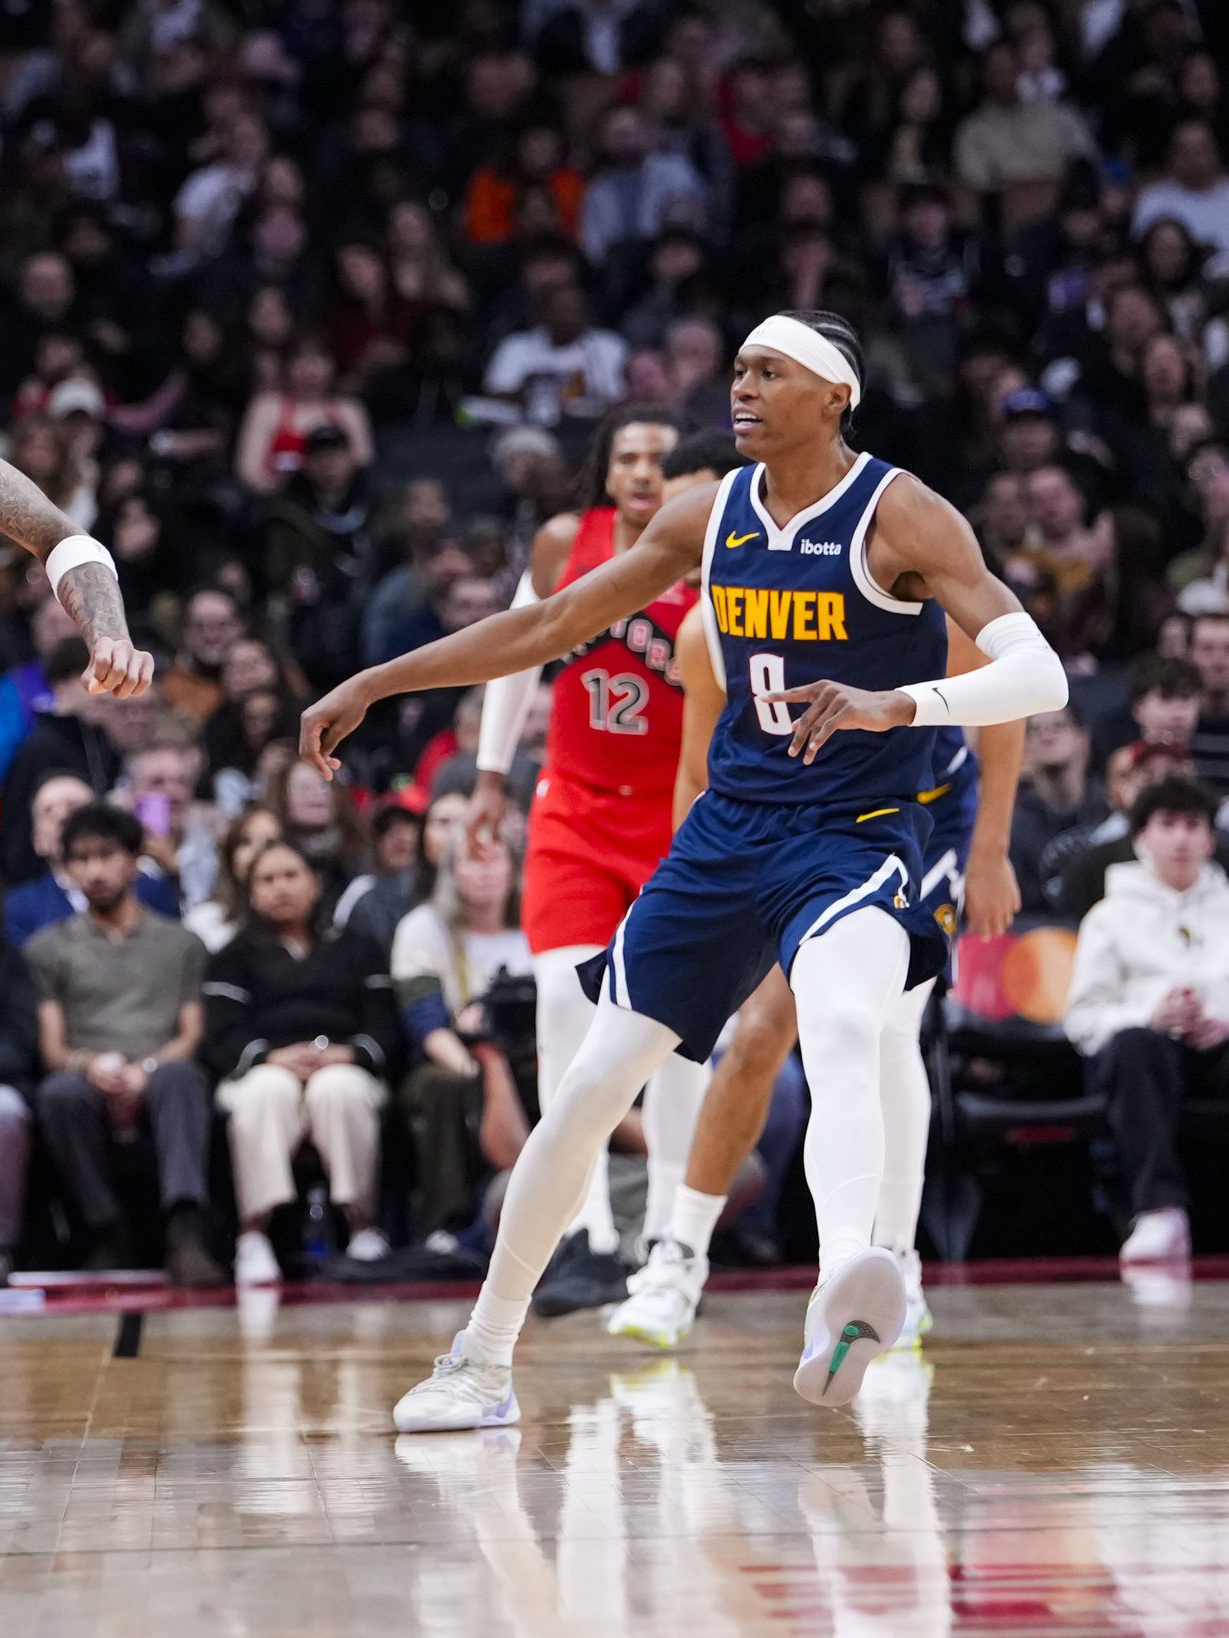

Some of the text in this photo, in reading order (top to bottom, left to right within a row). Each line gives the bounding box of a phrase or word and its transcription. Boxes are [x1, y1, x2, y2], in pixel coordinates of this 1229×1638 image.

[800, 538, 842, 556] ibotta
[711, 584, 849, 641] DENVER
[580, 667, 650, 736] 12
[749, 653, 793, 736] 8
